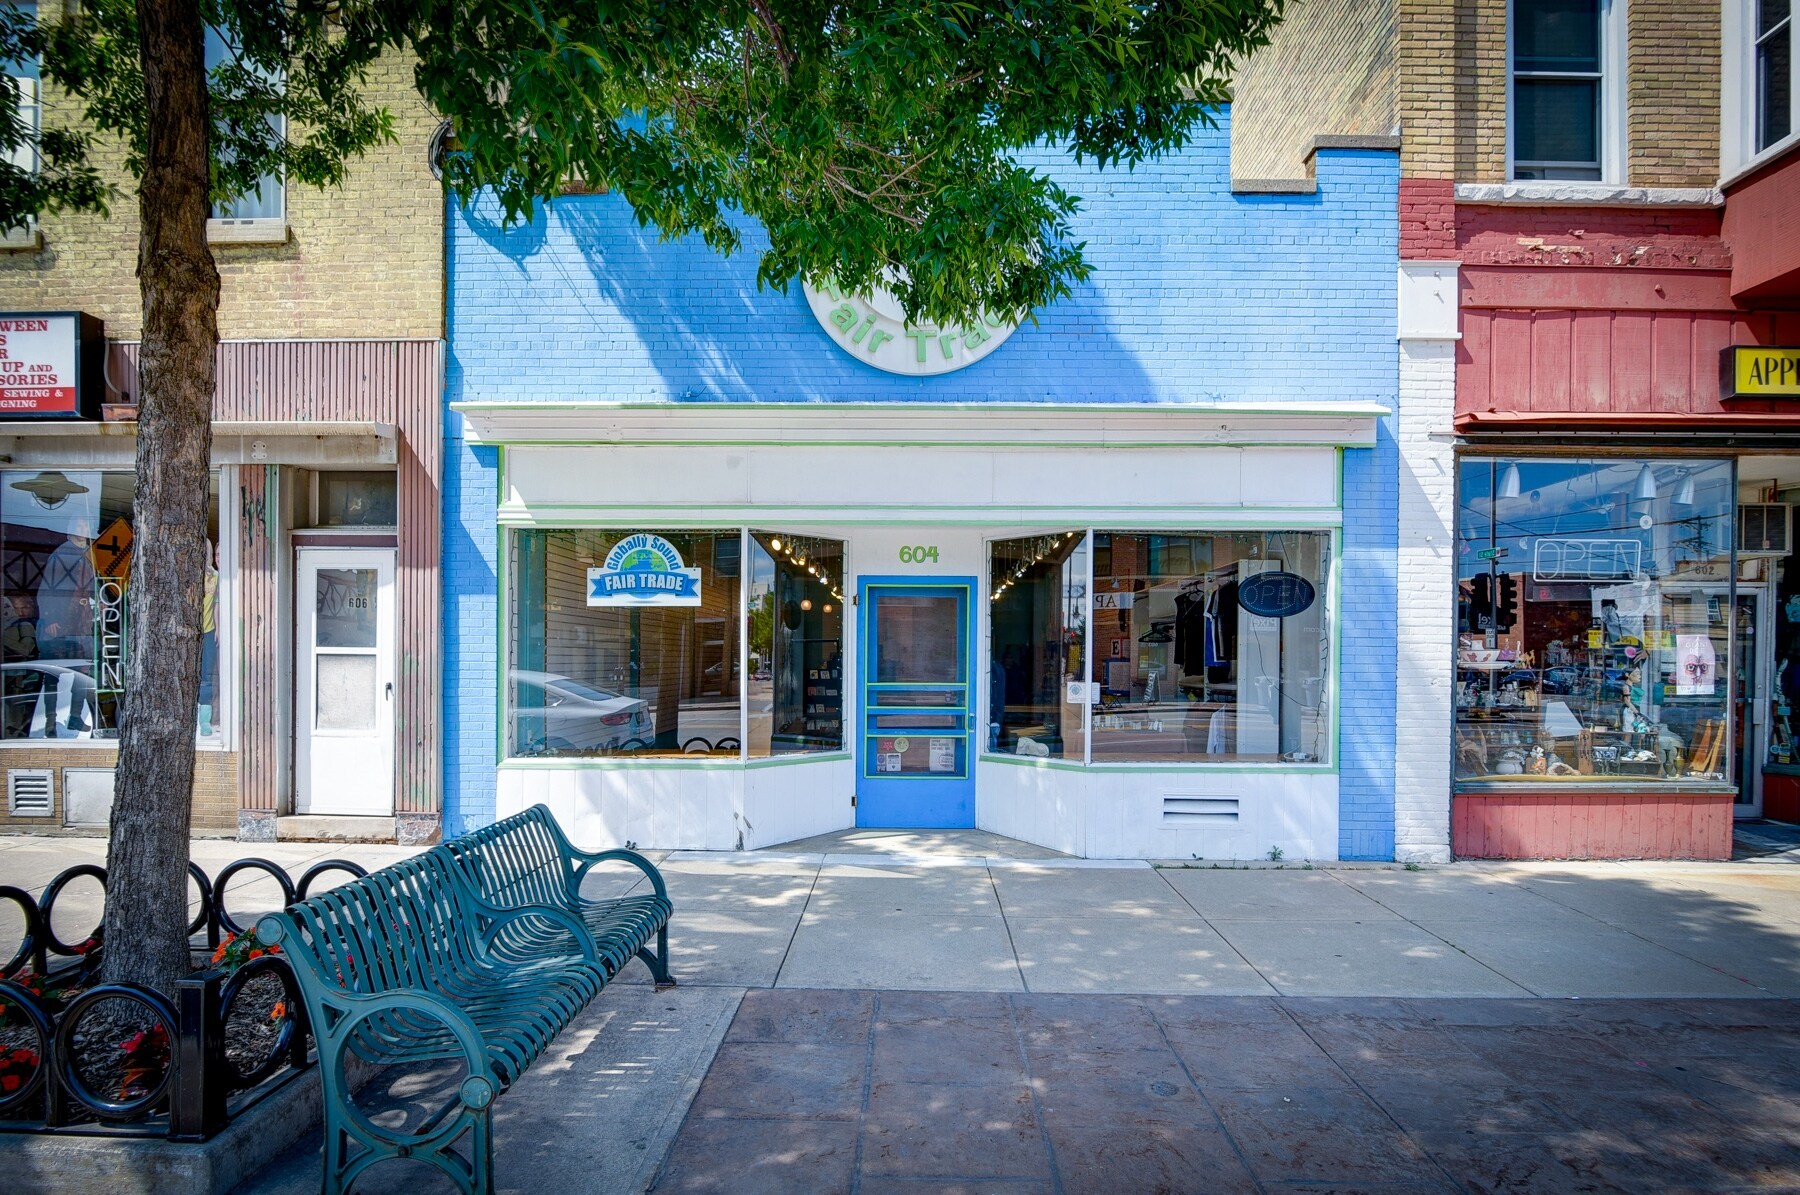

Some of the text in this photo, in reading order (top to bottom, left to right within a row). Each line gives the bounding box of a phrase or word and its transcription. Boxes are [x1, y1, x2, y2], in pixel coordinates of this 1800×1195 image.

[905, 306, 1005, 363] Tra
[2, 361, 53, 373] UP AND
[4, 389, 64, 397] SEWING &
[607, 535, 682, 571] Globally Sound
[899, 545, 940, 564] 604
[1537, 542, 1639, 579] OPEN
[1695, 565, 1715, 576] 602
[604, 573, 684, 591] FAIR TRADE
[1244, 585, 1308, 605] OPEN
[100, 582, 122, 686] OPEN
